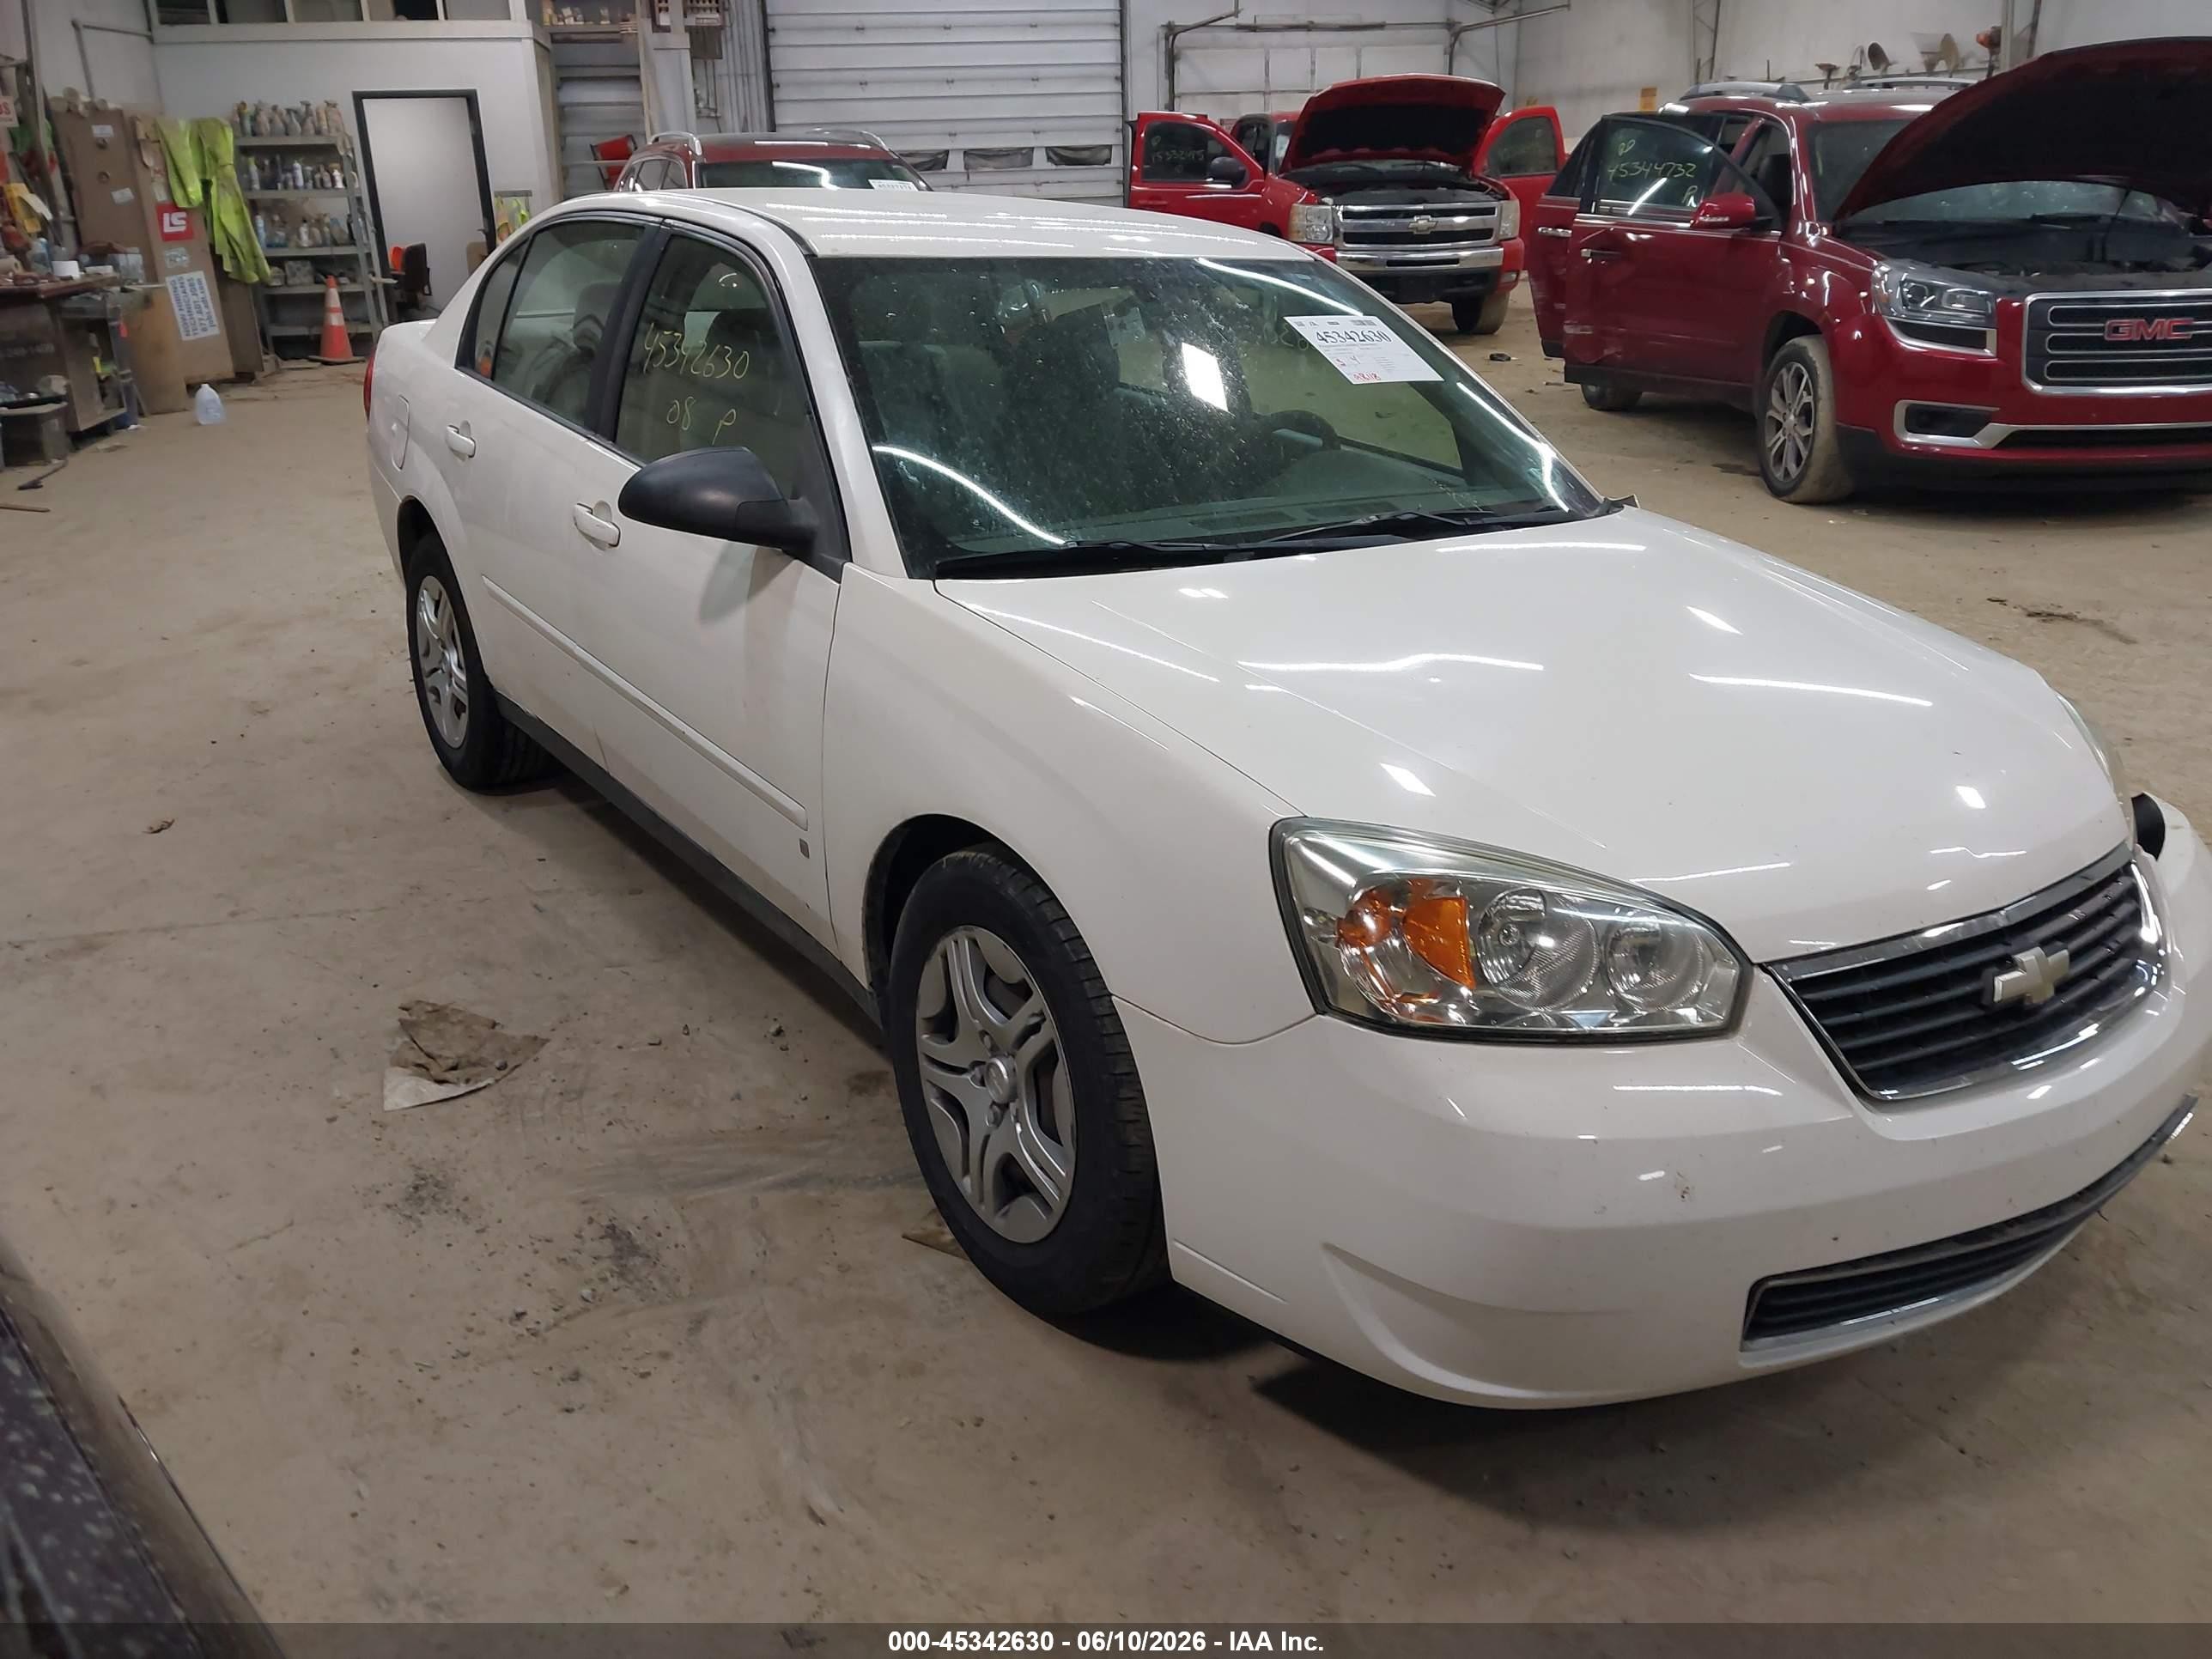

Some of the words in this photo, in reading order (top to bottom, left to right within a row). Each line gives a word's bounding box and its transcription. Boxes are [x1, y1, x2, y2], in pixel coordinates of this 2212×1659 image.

[176, 276, 198, 336] TECHNICIANS
[1316, 330, 1392, 343] 45342630
[2104, 318, 2194, 341] GMC
[643, 322, 750, 379] 45342630
